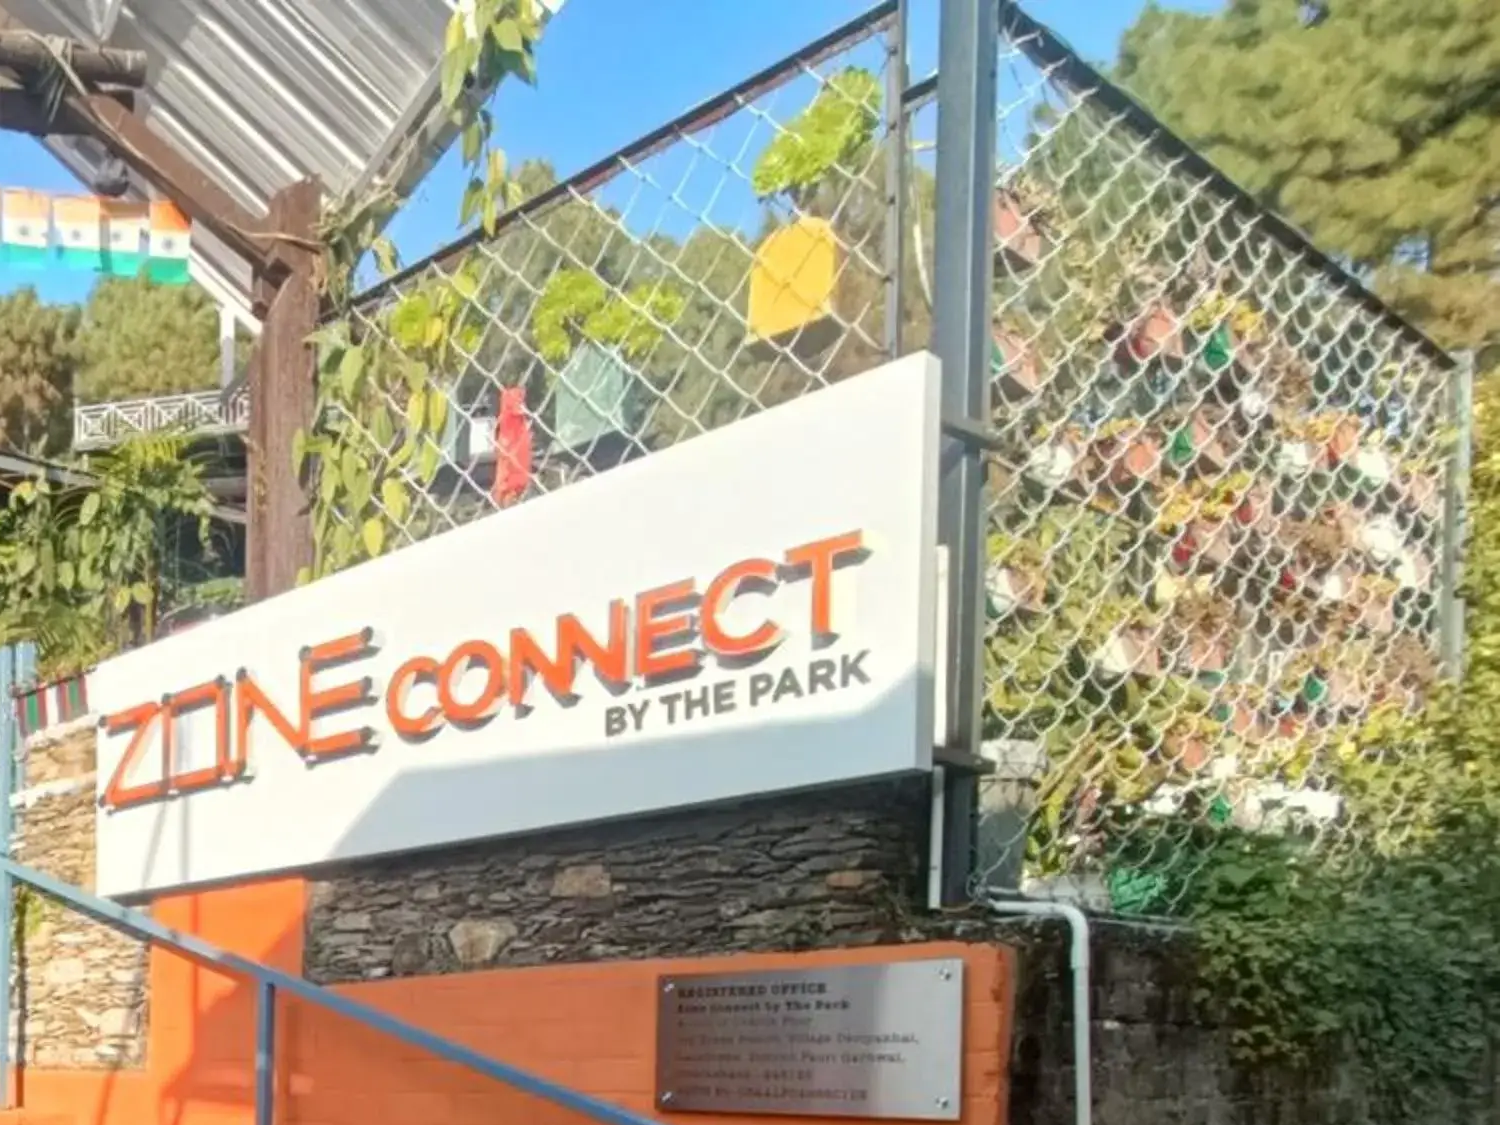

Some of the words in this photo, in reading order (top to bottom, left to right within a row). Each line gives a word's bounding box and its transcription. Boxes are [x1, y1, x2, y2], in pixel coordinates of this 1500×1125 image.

[98, 626, 376, 814] ZONE
[386, 529, 866, 737] CONNECT
[605, 699, 651, 737] BY
[659, 680, 737, 725] THE
[749, 649, 871, 707] PARK
[771, 983, 827, 996] OFFICE
